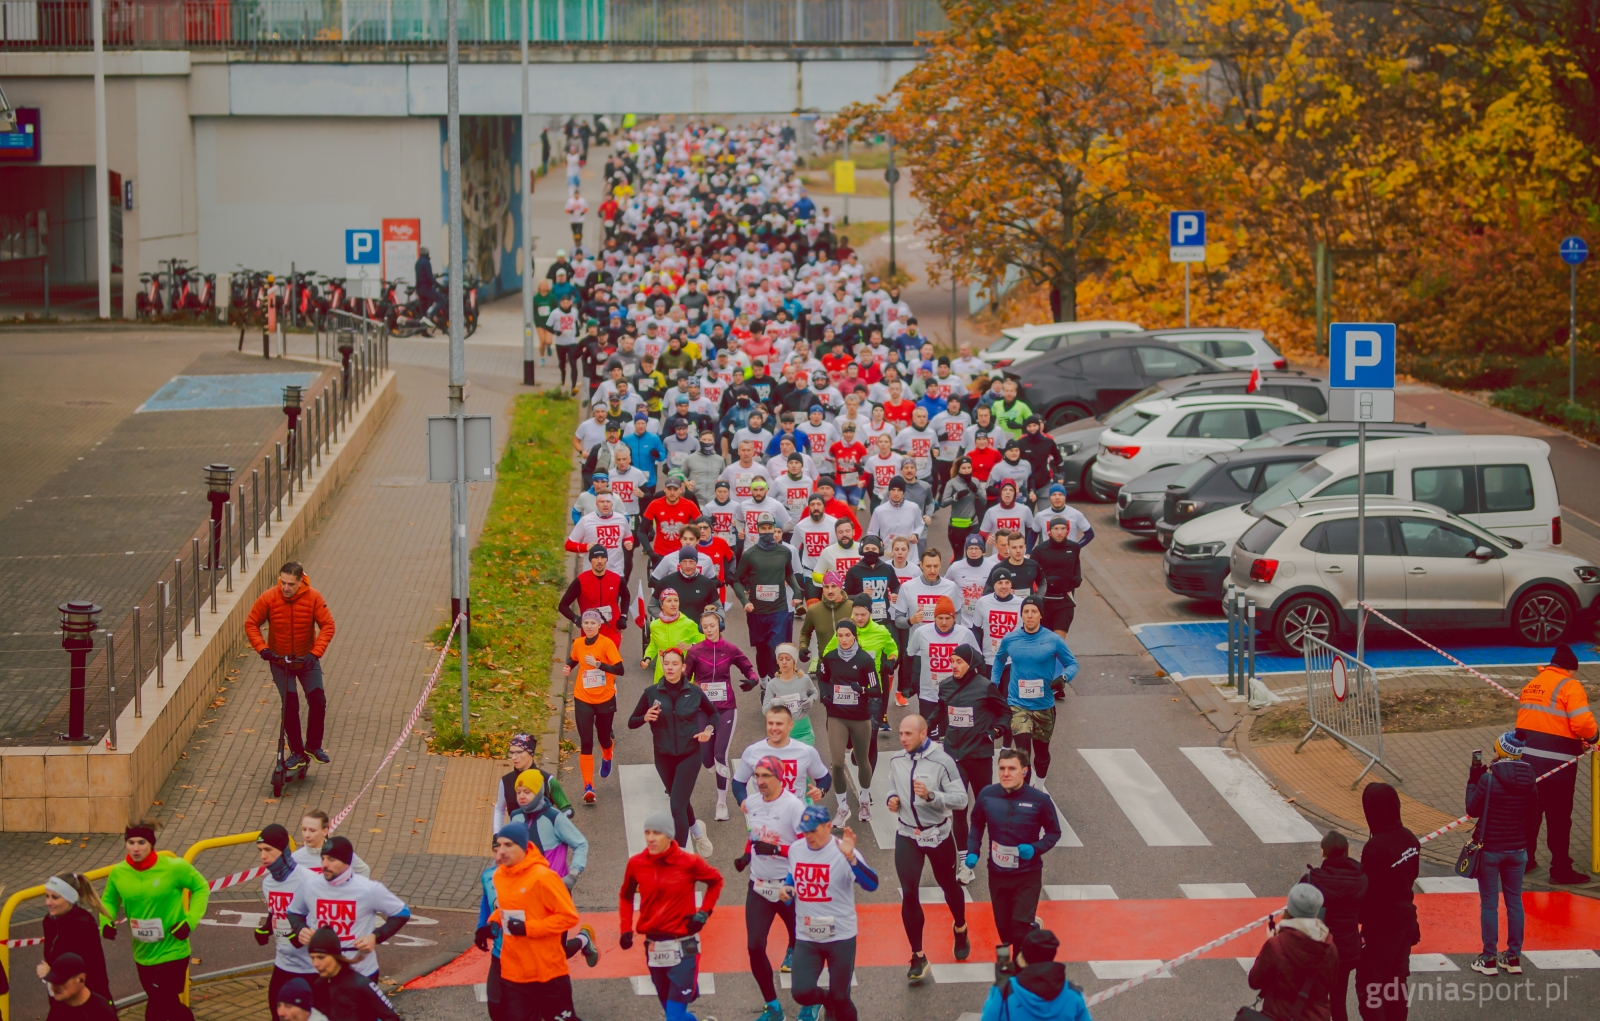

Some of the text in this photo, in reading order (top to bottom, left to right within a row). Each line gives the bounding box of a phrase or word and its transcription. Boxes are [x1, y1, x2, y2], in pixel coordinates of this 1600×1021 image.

[1177, 215, 1198, 243] P
[352, 232, 373, 261] P
[1345, 330, 1382, 380] P
[876, 467, 895, 475] RUN
[612, 483, 634, 492] RUN
[787, 490, 808, 499] RUN
[997, 519, 1020, 529] RUN
[597, 527, 620, 538] RUN
[597, 537, 619, 547] GDY
[805, 535, 829, 545] RUN
[863, 580, 887, 590] RUN
[989, 613, 1018, 626] RUN
[990, 624, 1015, 636] GDY
[795, 867, 830, 884] RUN
[796, 883, 829, 898] GDY
[268, 896, 289, 911] RUN
[316, 904, 356, 921] RUN
